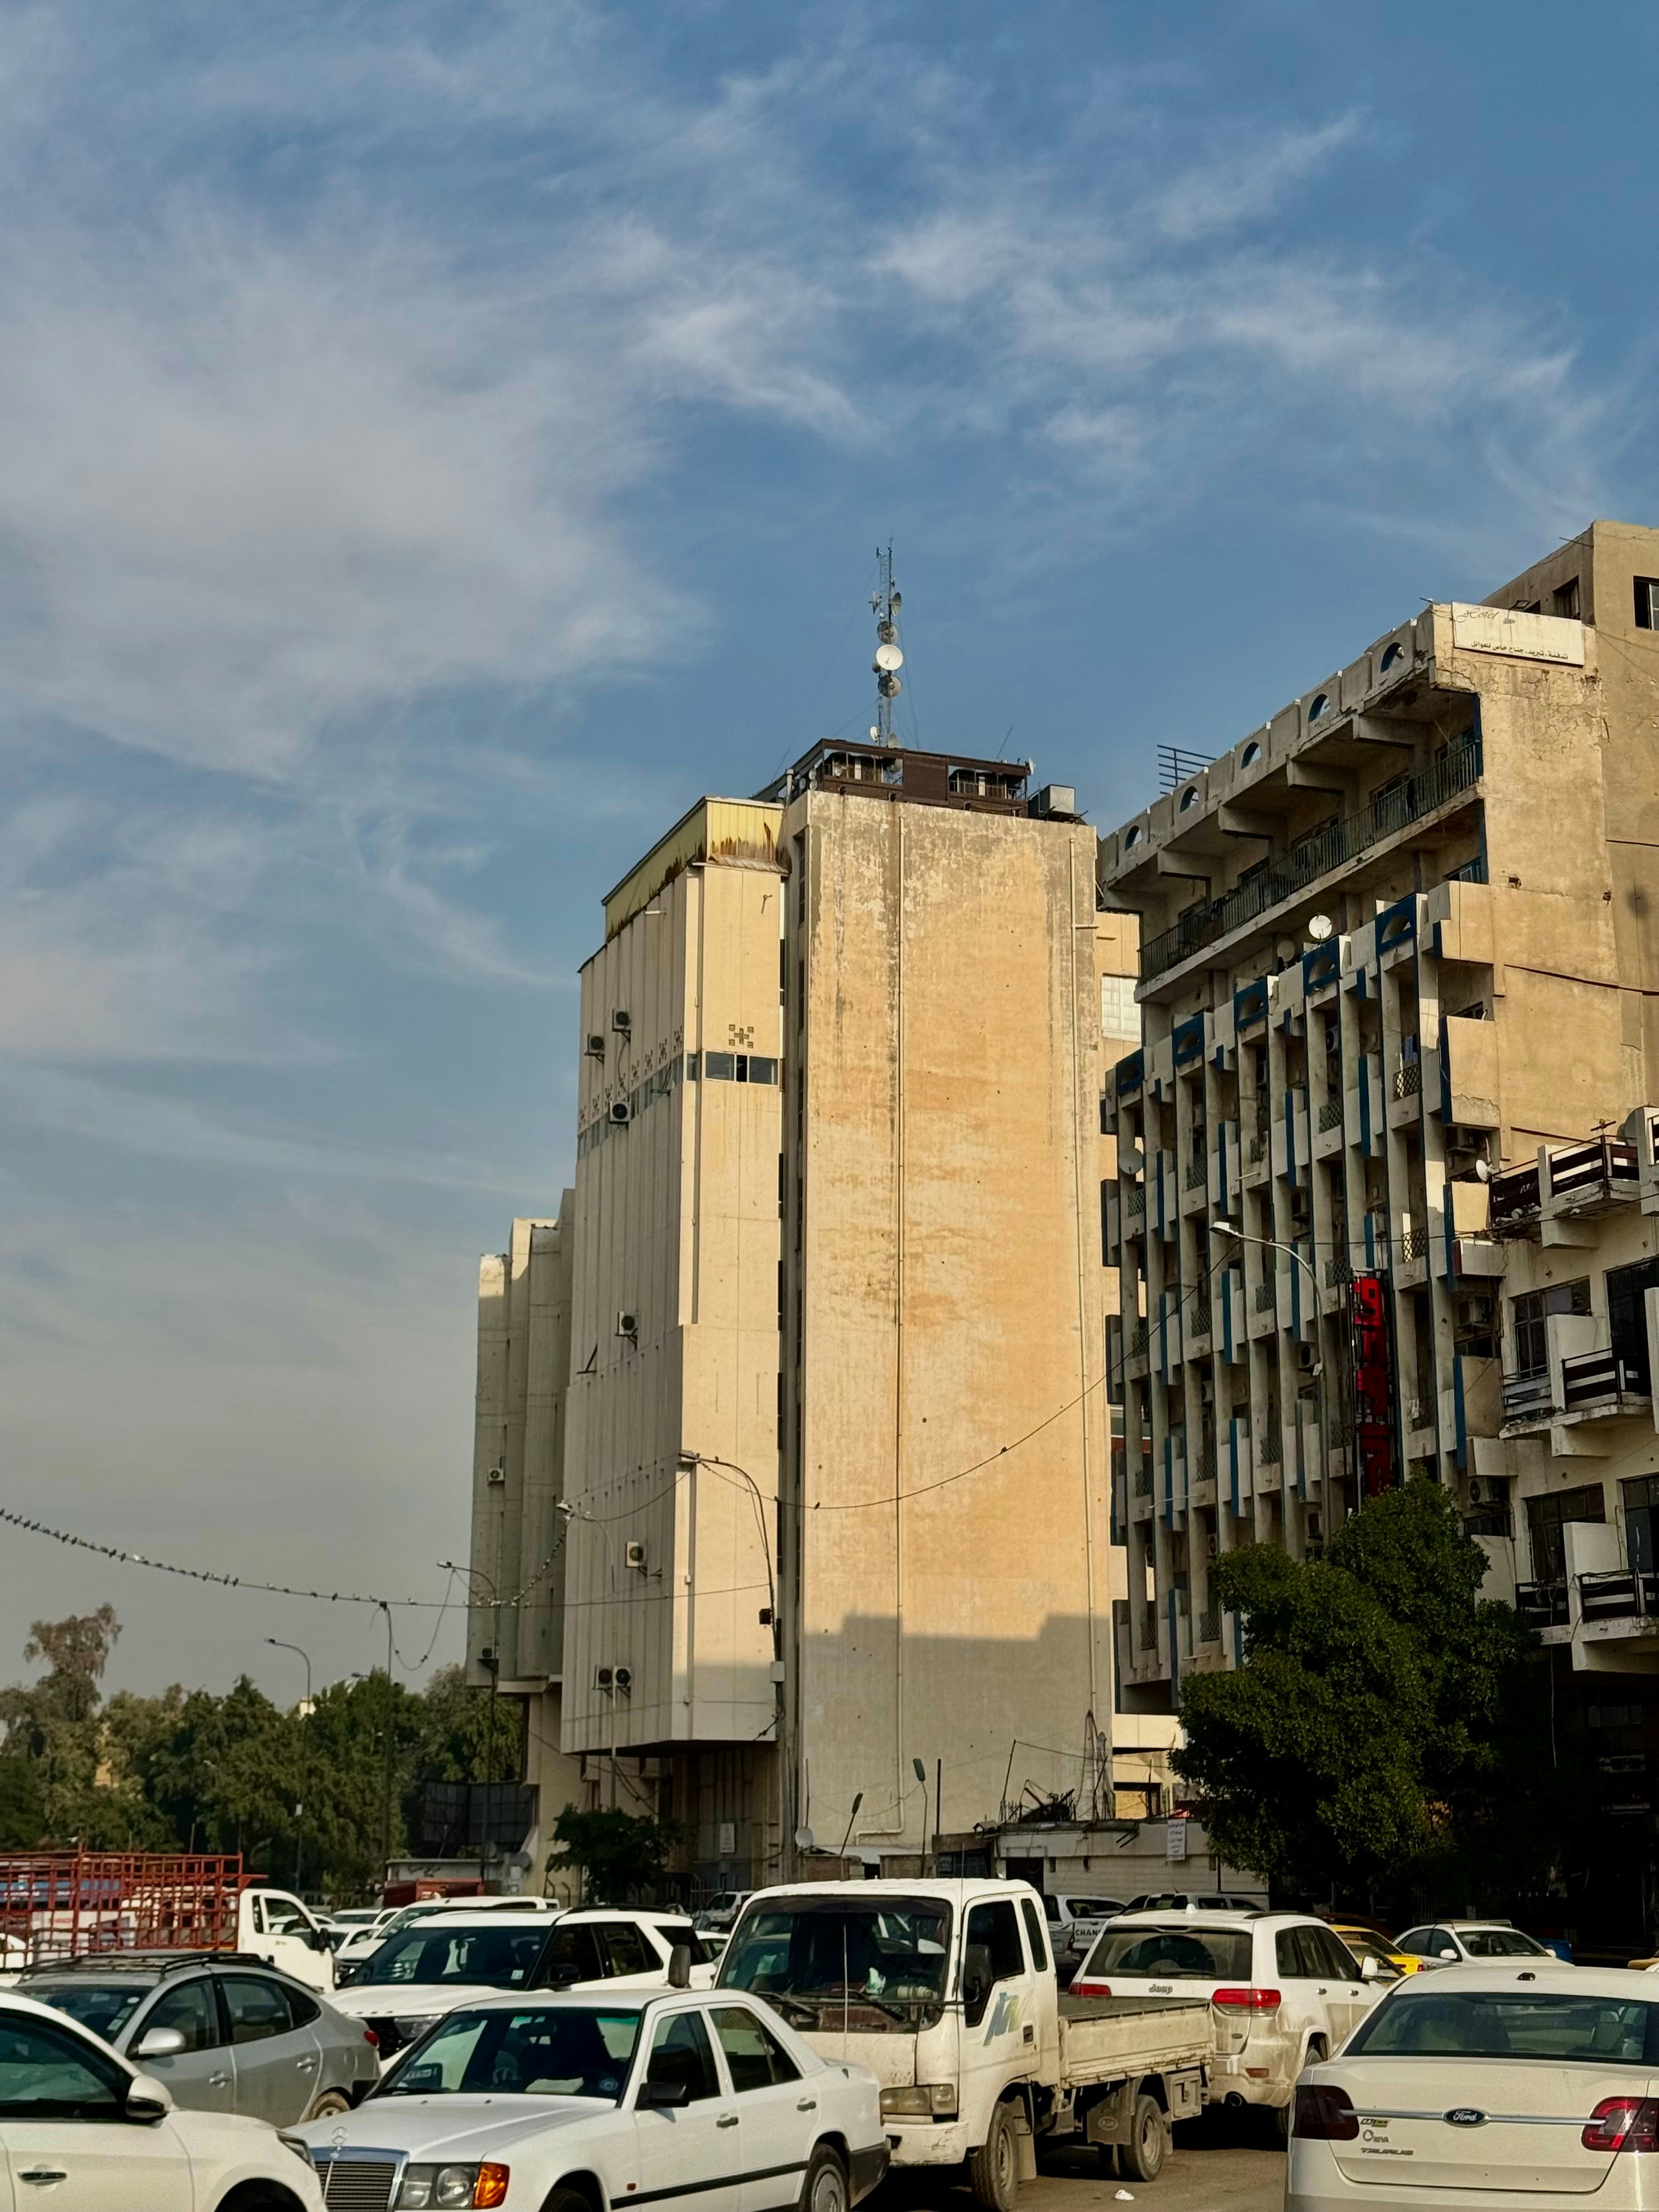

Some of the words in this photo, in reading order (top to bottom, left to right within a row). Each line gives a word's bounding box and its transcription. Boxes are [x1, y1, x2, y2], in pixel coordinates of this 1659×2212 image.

[1455, 607, 1500, 623] Hotel
[1149, 1983, 1173, 1995] Jeep
[1453, 2110, 1477, 2121] Ford
[1361, 2147, 1414, 2155] TAURUS
